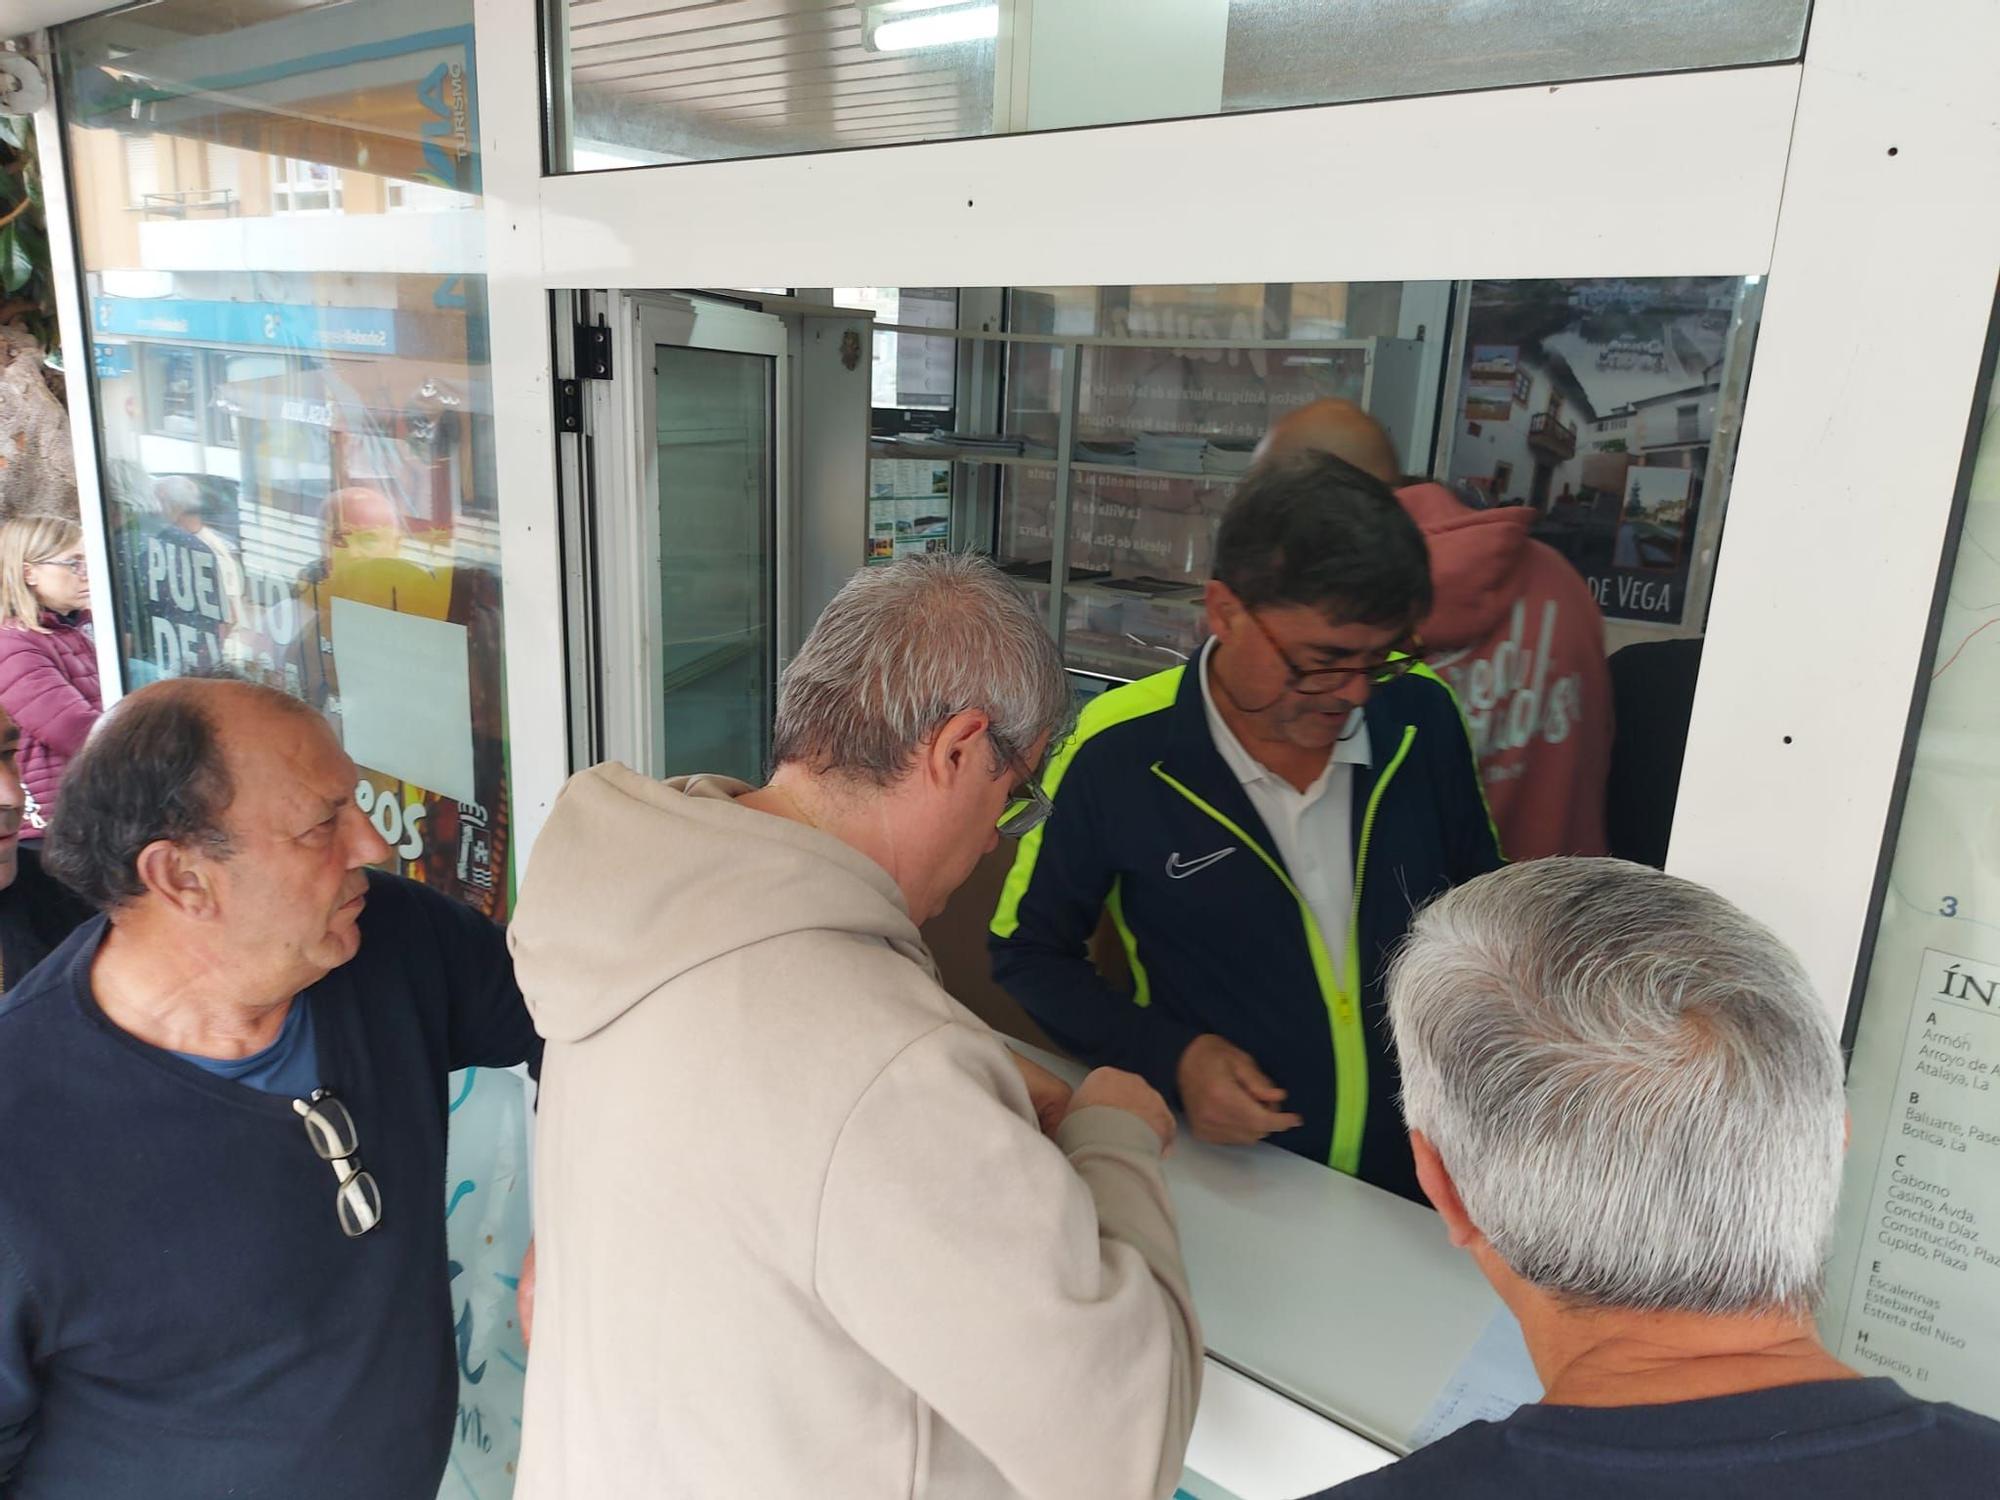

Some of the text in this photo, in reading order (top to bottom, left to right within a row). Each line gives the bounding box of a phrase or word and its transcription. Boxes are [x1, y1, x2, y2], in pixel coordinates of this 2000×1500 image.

[447, 62, 466, 163] TURISMO
[1617, 575, 1670, 613] VEGA
[1938, 896, 1958, 917] 3
[1937, 963, 2000, 1008] ÍN
[1926, 1011, 1937, 1025] A
[1921, 1028, 1971, 1052] Armón
[1918, 1044, 1966, 1068] Arroyo
[1968, 1058, 1988, 1073] de
[1914, 1060, 1990, 1091] Atalaya, La
[1908, 1091, 1920, 1104] B
[1905, 1106, 1964, 1137] Baluarte,
[1902, 1122, 1967, 1153] Botica, La
[1895, 1154, 1906, 1167] C
[1891, 1169, 1950, 1198] Caborno
[1887, 1184, 1935, 1213] Casino,
[1884, 1200, 1979, 1241] Conchita Díaz
[1878, 1230, 1968, 1271] Cupido, Plaza
[1881, 1215, 1969, 1257] Constitución,
[1871, 1260, 1881, 1273] E
[1857, 1329, 1869, 1344] H
[1910, 1319, 1932, 1337] del
[1854, 1343, 1912, 1378] Hospicio,
